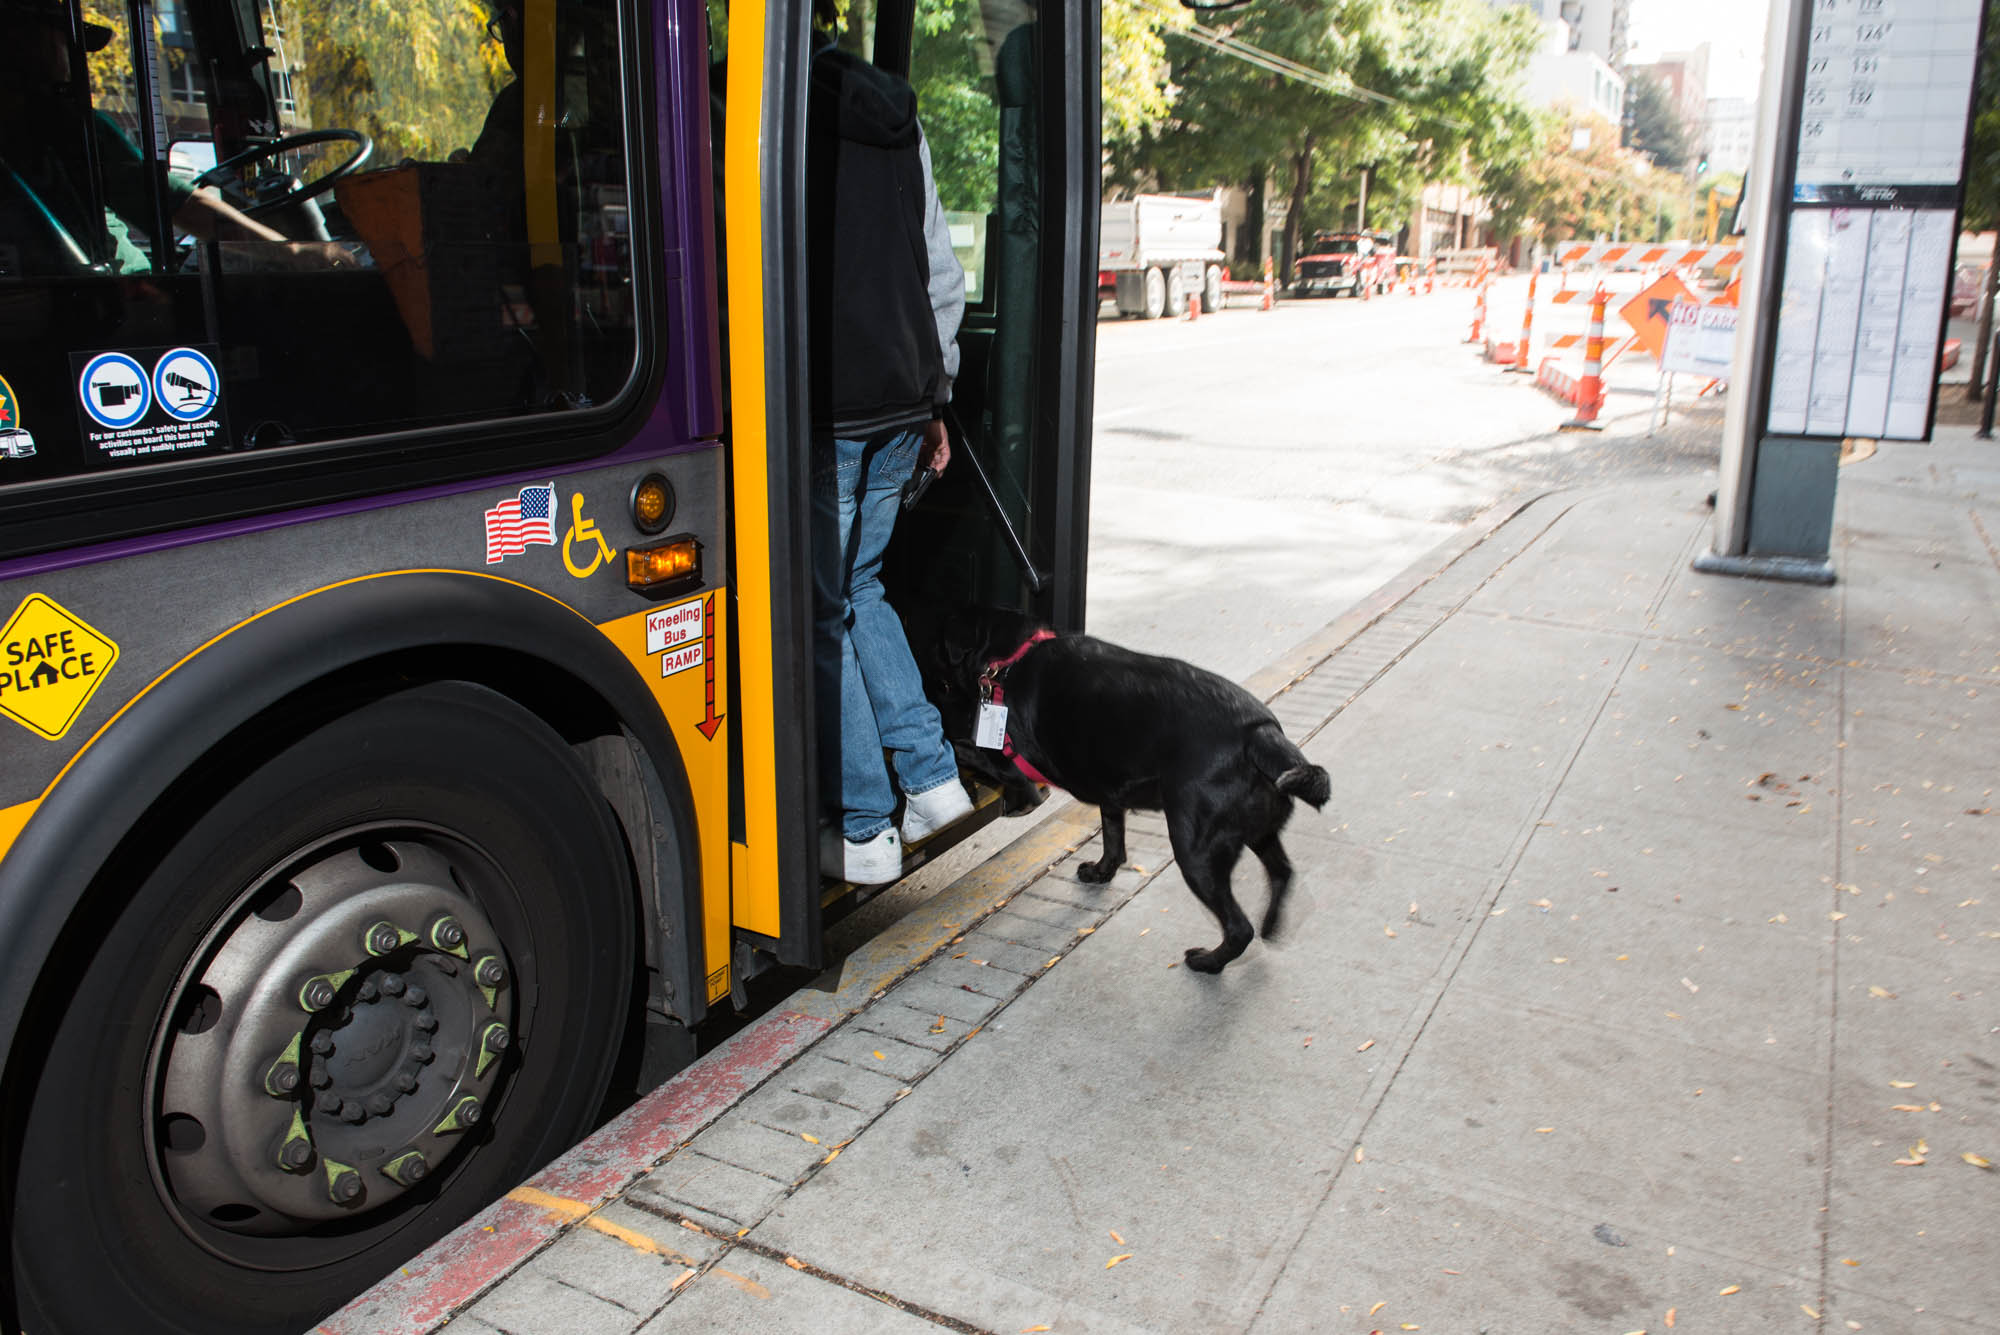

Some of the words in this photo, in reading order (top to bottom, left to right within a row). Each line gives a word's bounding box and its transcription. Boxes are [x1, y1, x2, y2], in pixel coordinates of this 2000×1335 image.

[89, 432, 102, 441] For
[103, 432, 115, 440] our
[116, 426, 155, 438] customers'
[156, 424, 178, 434] safety
[178, 423, 191, 431] and
[99, 439, 132, 449] activities
[143, 435, 163, 444] board
[164, 434, 177, 442] this
[177, 432, 190, 440] bus
[191, 431, 205, 439] may
[205, 429, 214, 437] be
[109, 447, 136, 457] visually
[137, 445, 150, 453] and
[151, 443, 175, 453] audibly
[176, 438, 207, 449] recorded.
[649, 607, 701, 632] Kneeling
[664, 628, 687, 645] Bus
[6, 630, 75, 666] SAFE
[665, 647, 701, 672] RAMP
